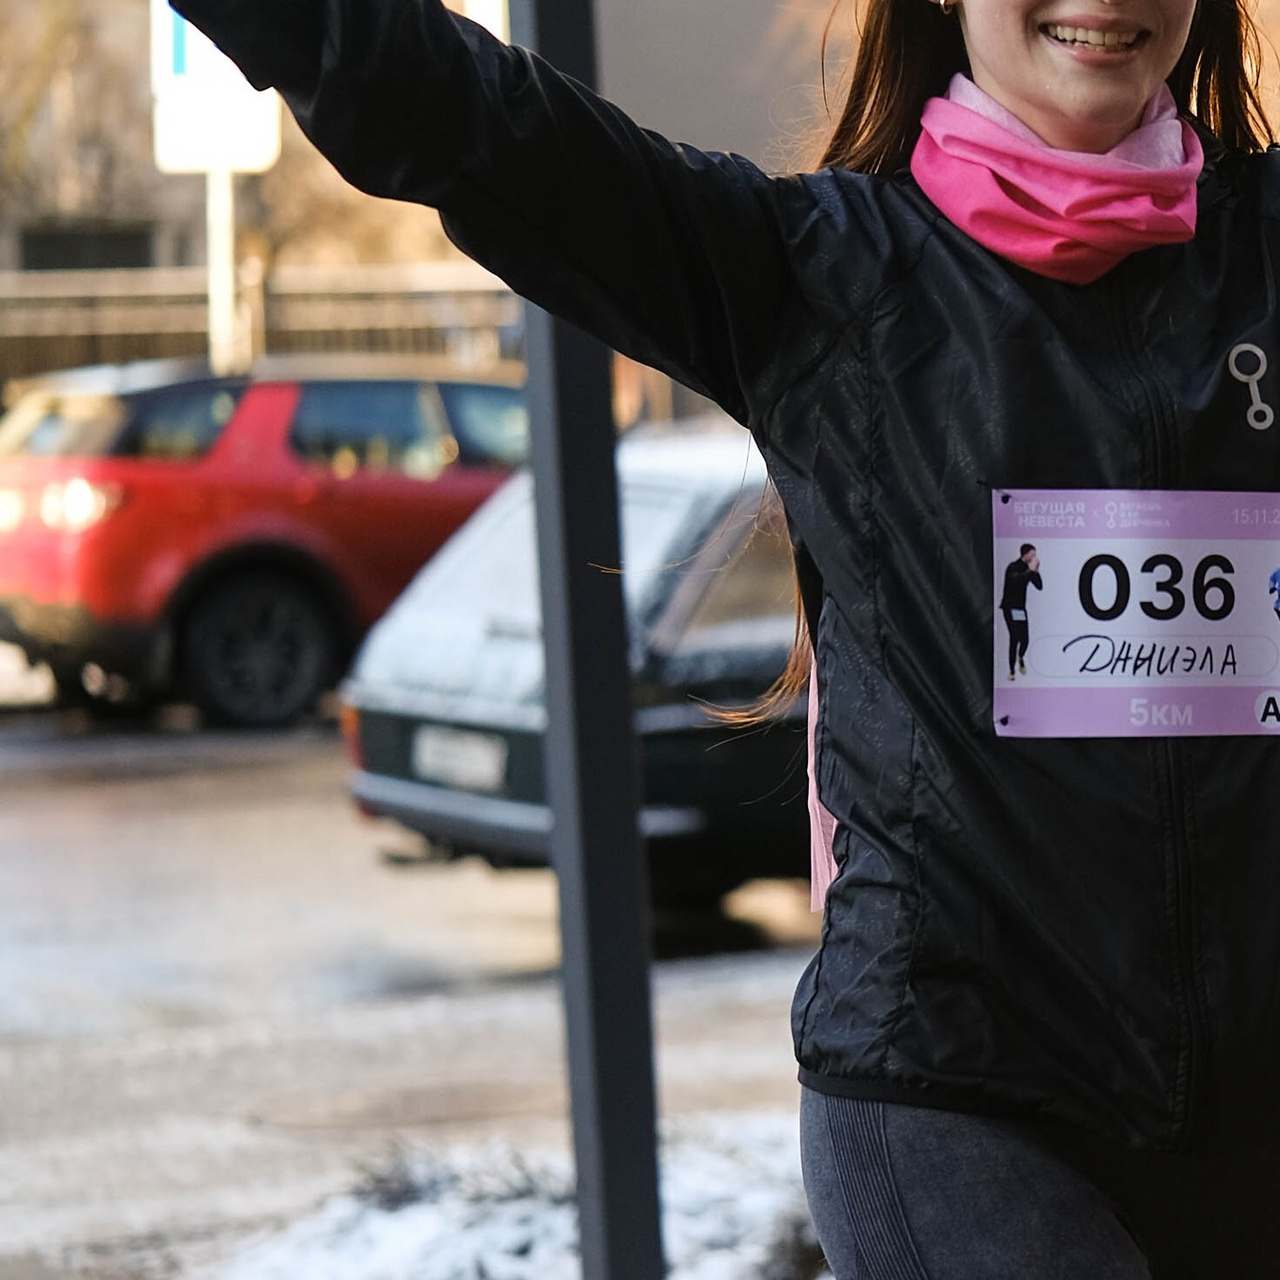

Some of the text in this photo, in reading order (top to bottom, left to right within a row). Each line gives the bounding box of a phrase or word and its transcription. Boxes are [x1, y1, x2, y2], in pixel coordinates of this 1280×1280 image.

[1013, 500, 1086, 515] БЕГУЩАЯ
[1017, 514, 1086, 528] НЕВЕСТА
[1077, 553, 1236, 622] 036
[1062, 634, 1238, 677] ДАНИЭЛА
